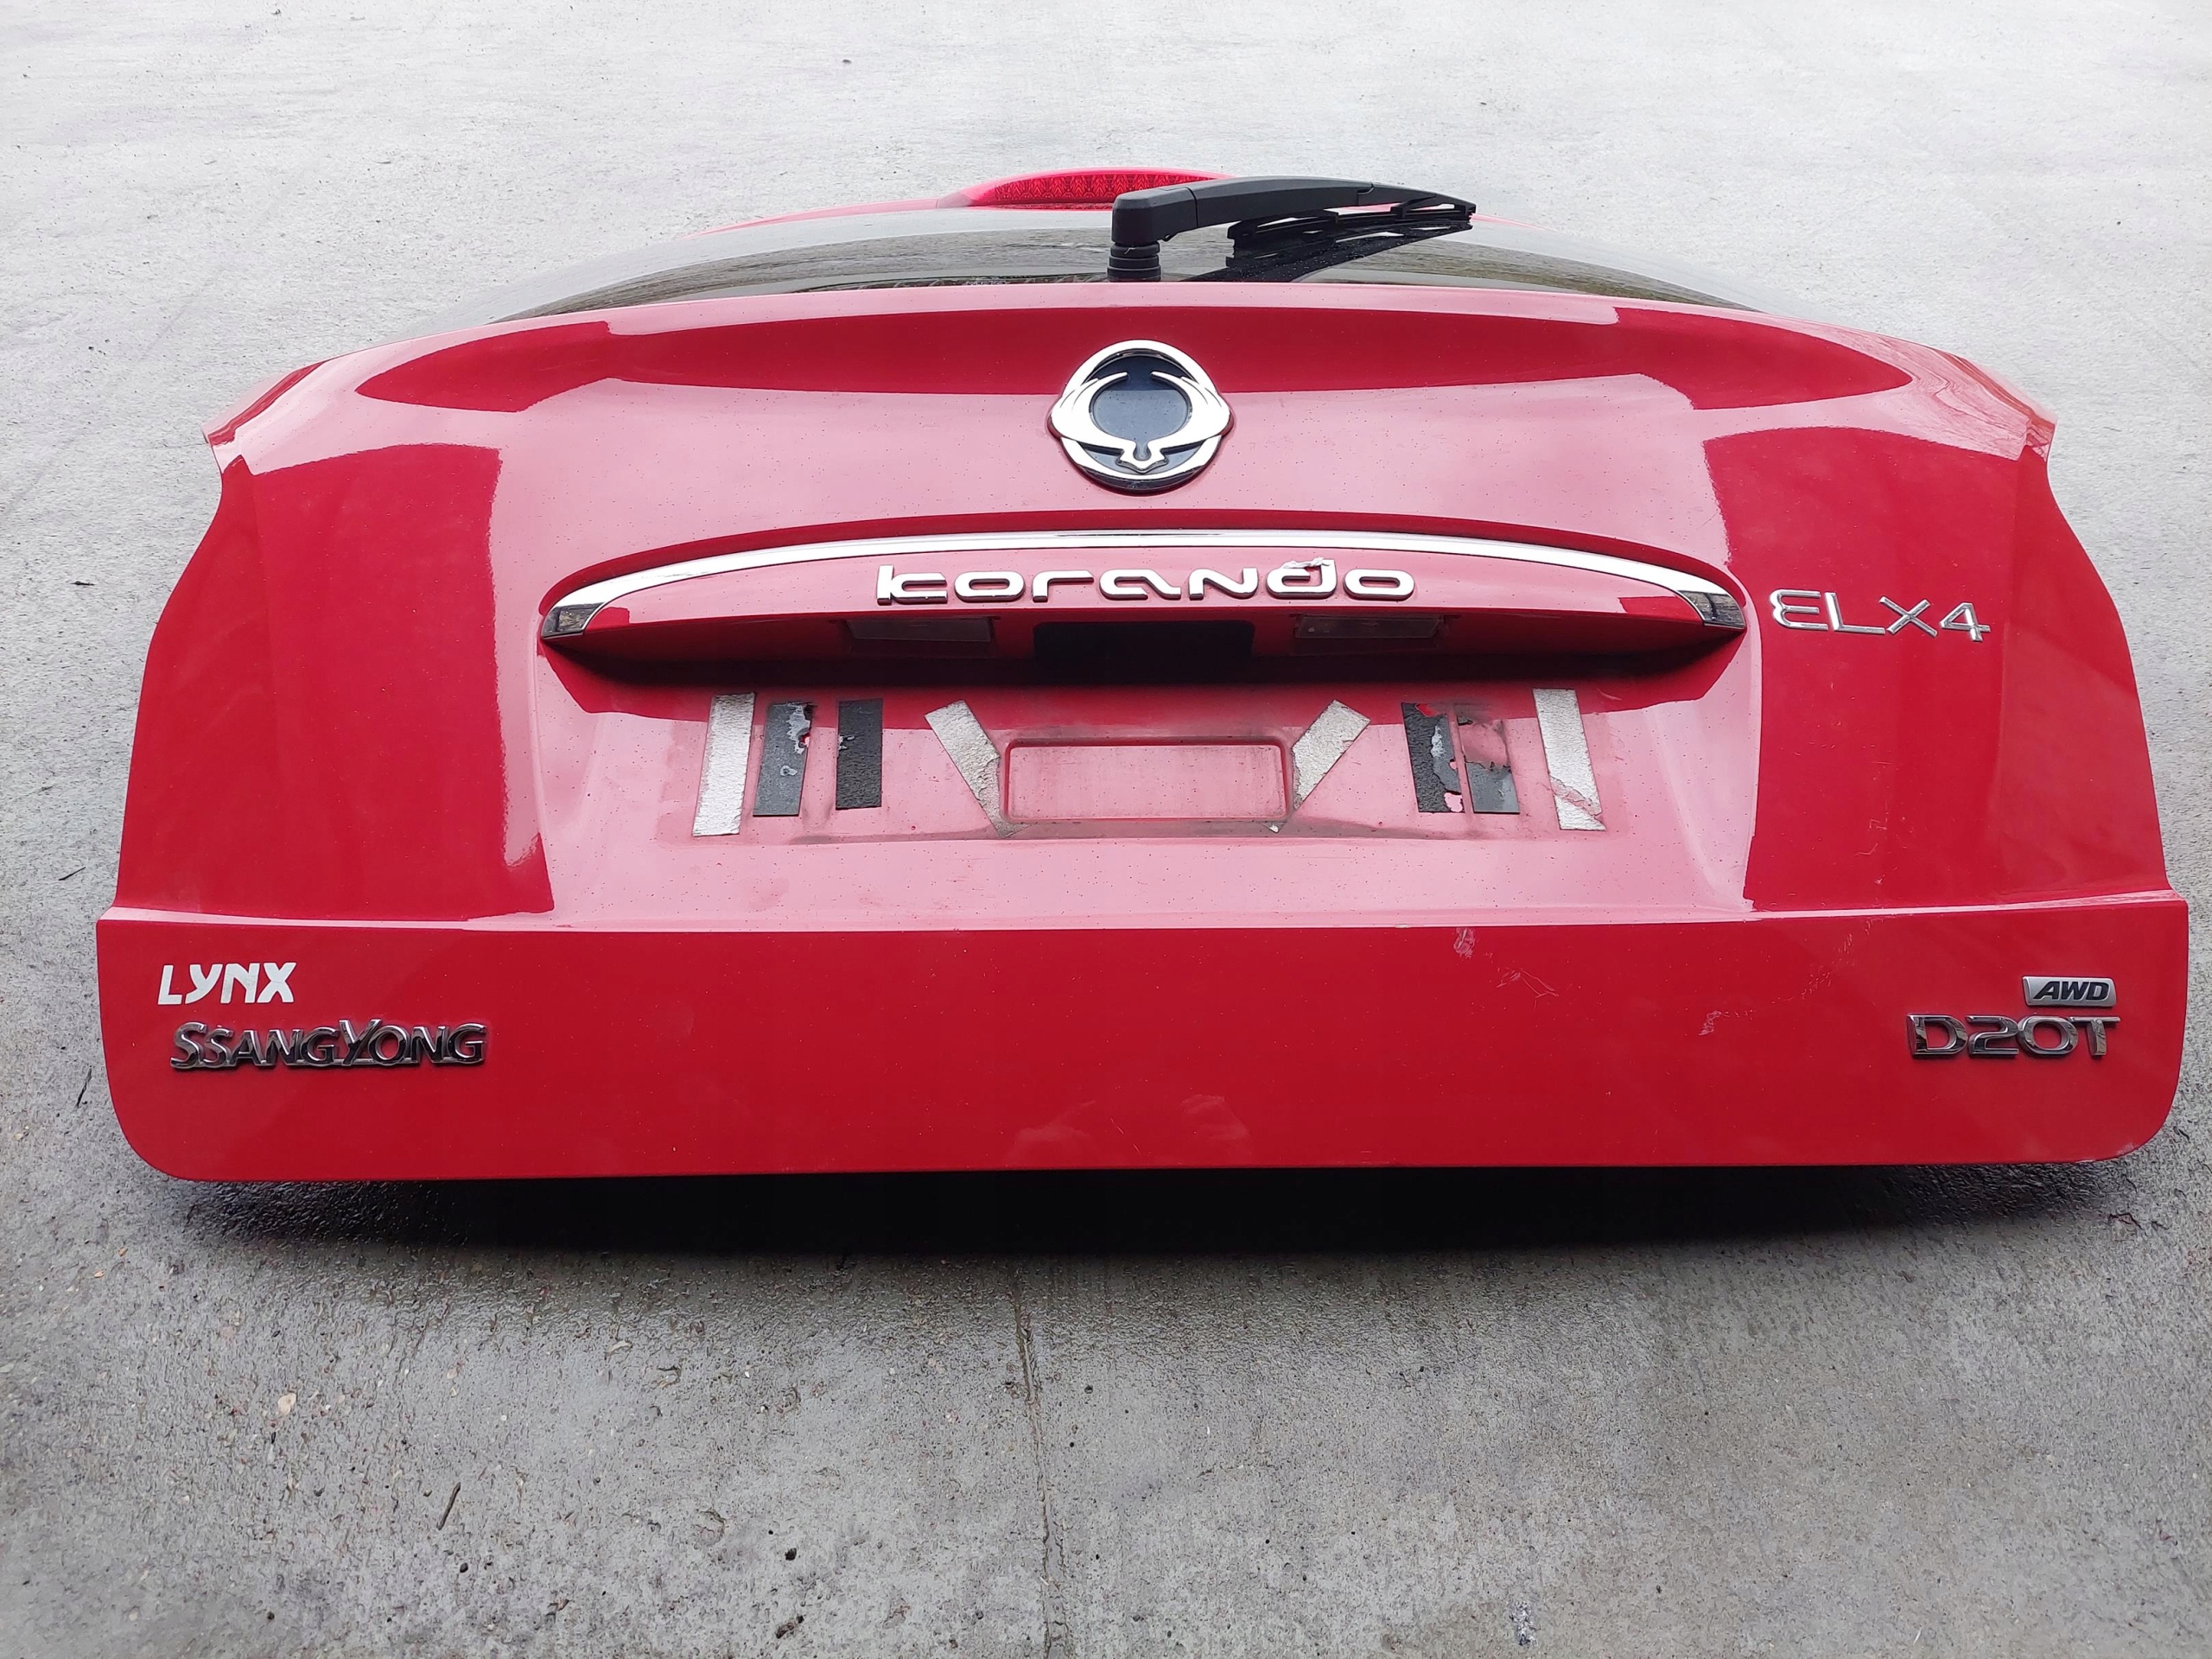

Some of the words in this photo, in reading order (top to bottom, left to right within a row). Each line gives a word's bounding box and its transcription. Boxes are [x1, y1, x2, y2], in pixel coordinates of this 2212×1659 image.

[1770, 588, 1991, 642] ELX4
[157, 962, 297, 1005] LYNX
[2033, 981, 2110, 1001] AWD
